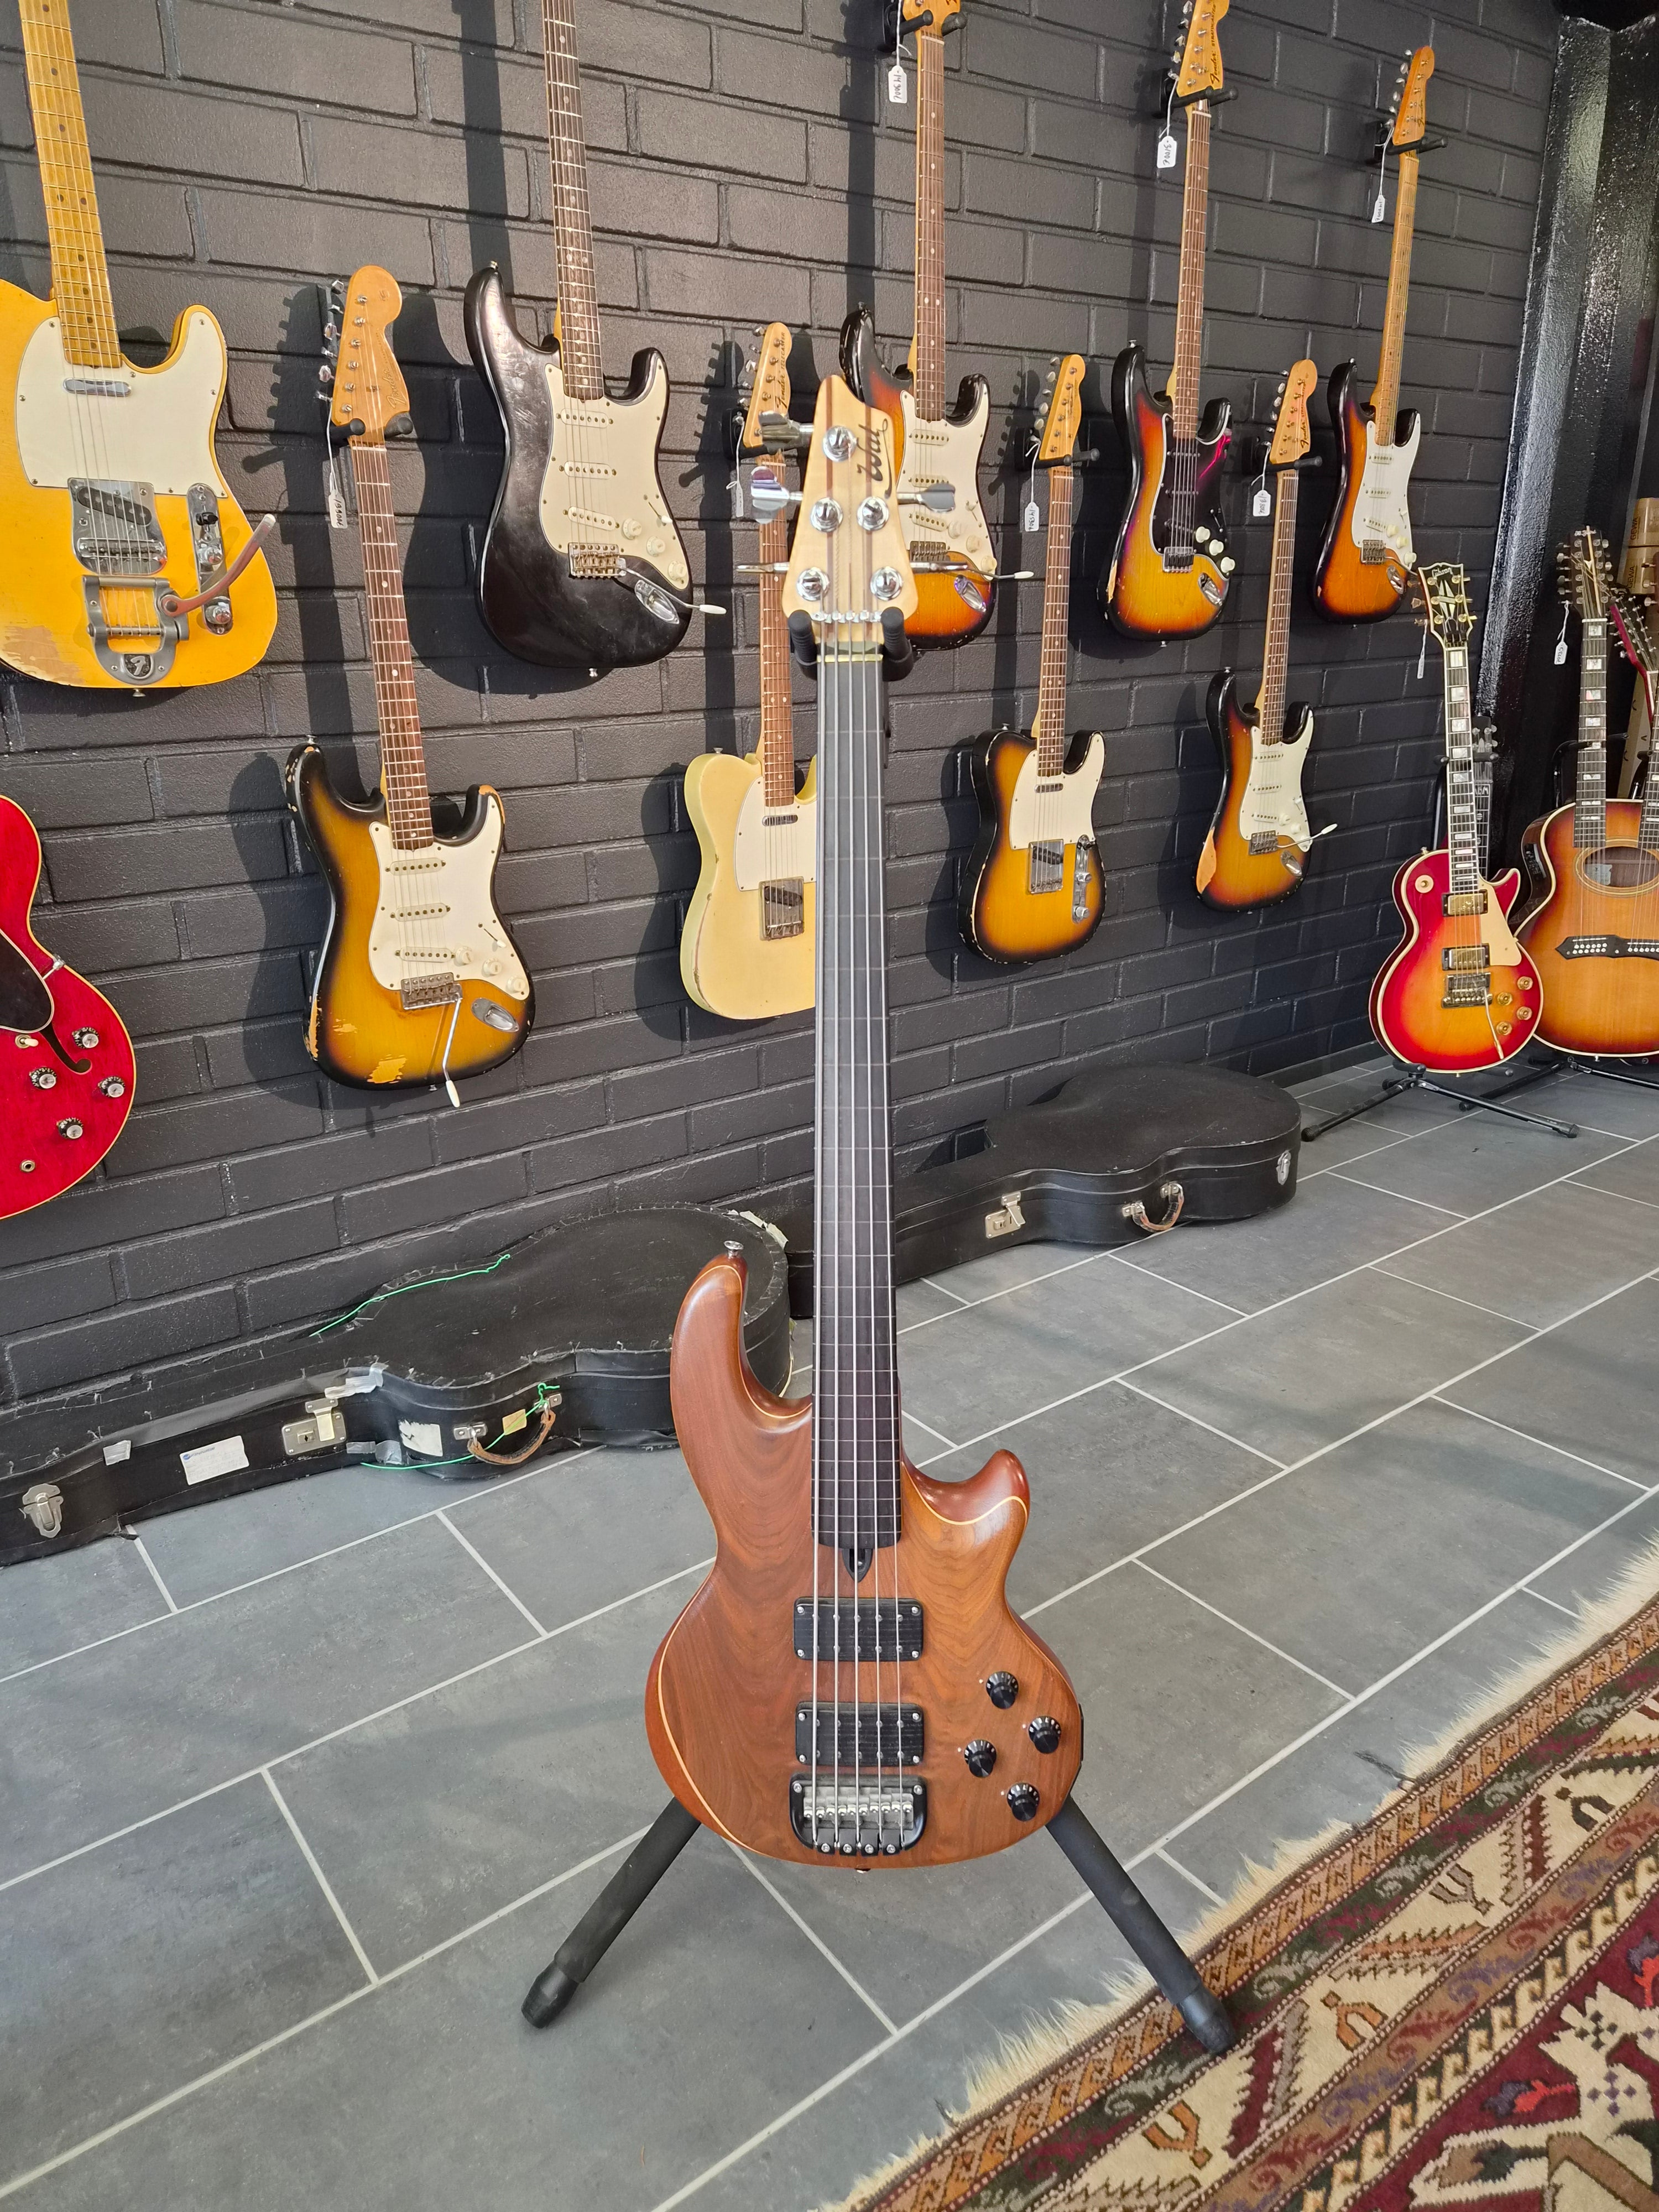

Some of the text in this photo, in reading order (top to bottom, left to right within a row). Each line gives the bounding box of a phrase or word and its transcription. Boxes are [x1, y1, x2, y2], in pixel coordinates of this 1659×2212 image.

[1210, 53, 1220, 84] Fender
[383, 367, 407, 409] Fender
[775, 374, 787, 409] Fender
[1300, 422, 1309, 448] Fender
[1432, 567, 1453, 580] Gibson
